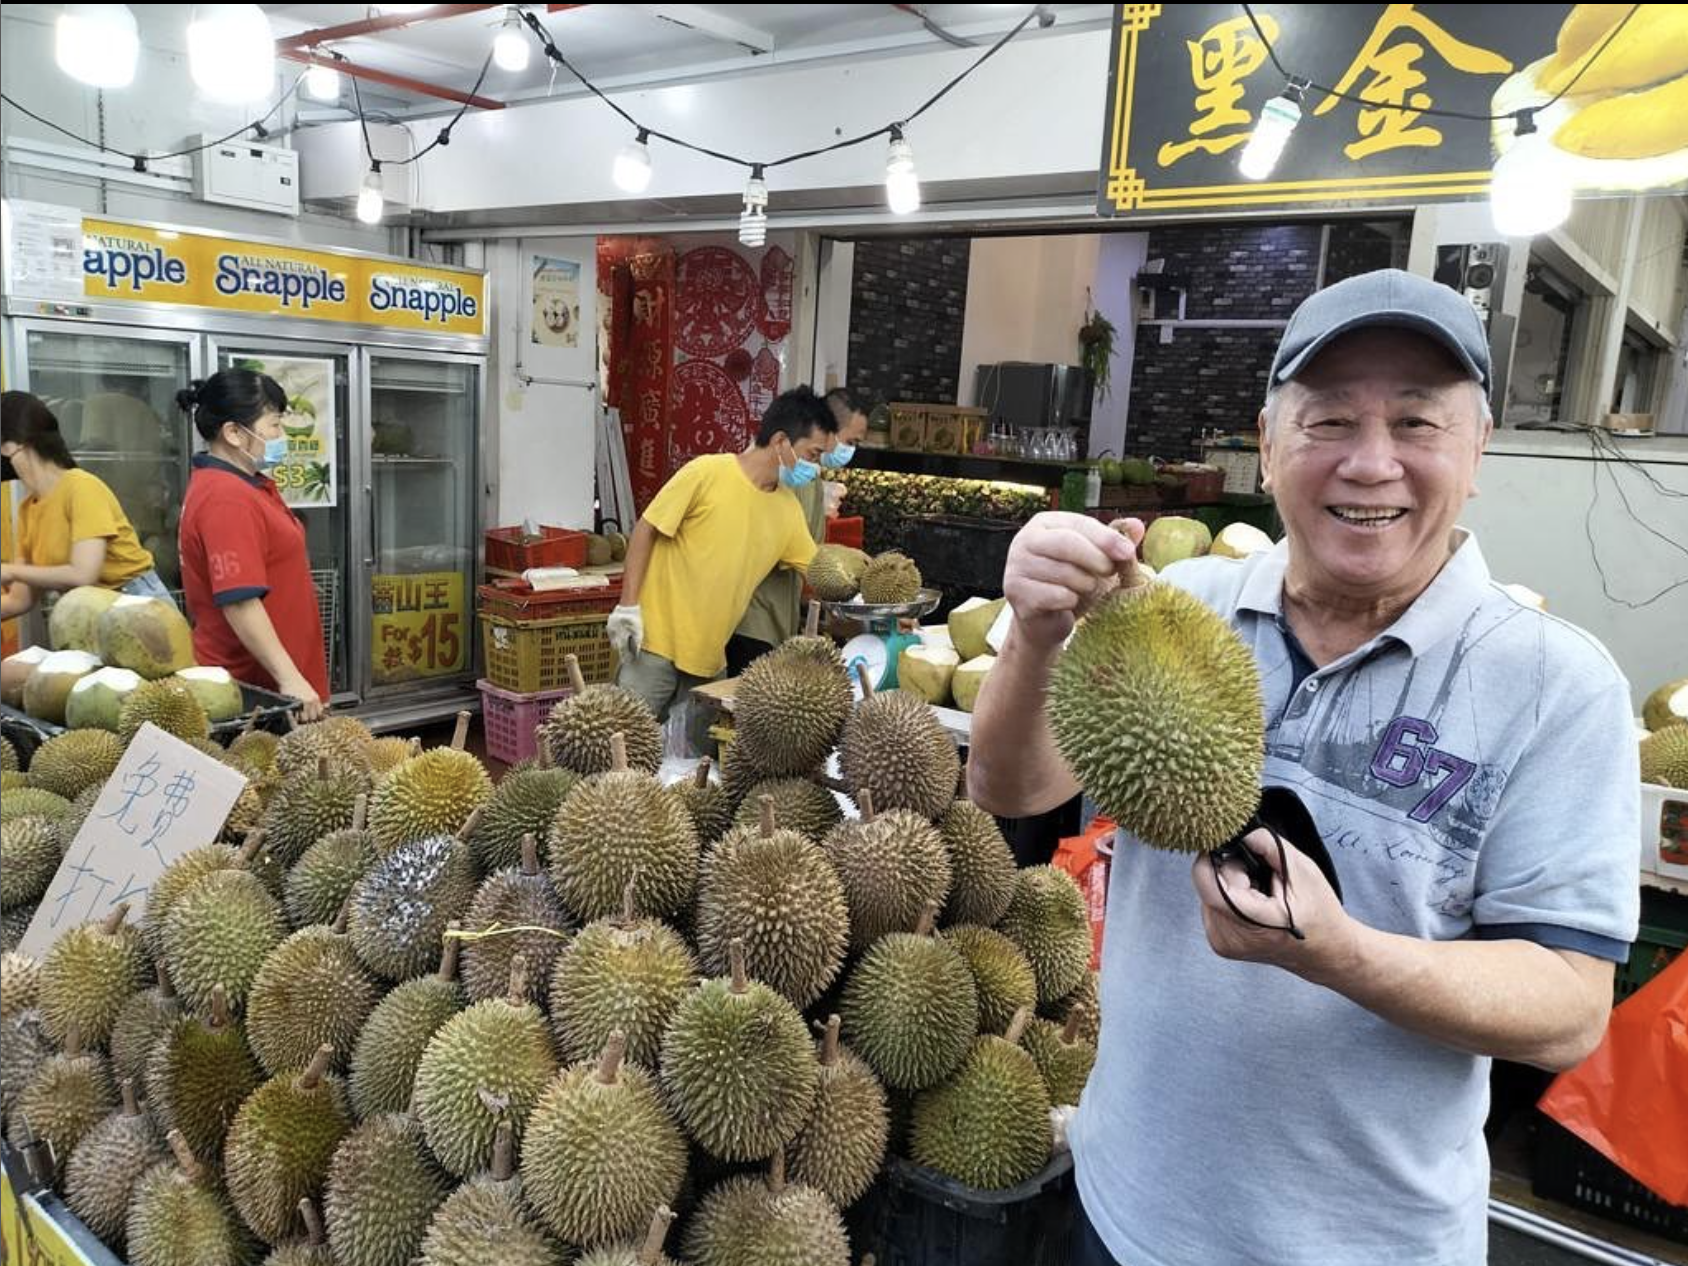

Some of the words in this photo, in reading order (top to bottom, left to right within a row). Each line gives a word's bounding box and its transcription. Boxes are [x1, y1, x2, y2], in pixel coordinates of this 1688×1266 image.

[1157, 4, 1513, 167] 黑金
[86, 233, 152, 253] ATURAL
[215, 254, 346, 308] Snapple
[264, 259, 319, 275] NATURAL
[370, 278, 477, 322] Snapple
[273, 464, 305, 489] $3
[209, 551, 241, 581] 36
[382, 624, 410, 643] For
[408, 613, 459, 669] $15
[1369, 716, 1477, 824] 67
